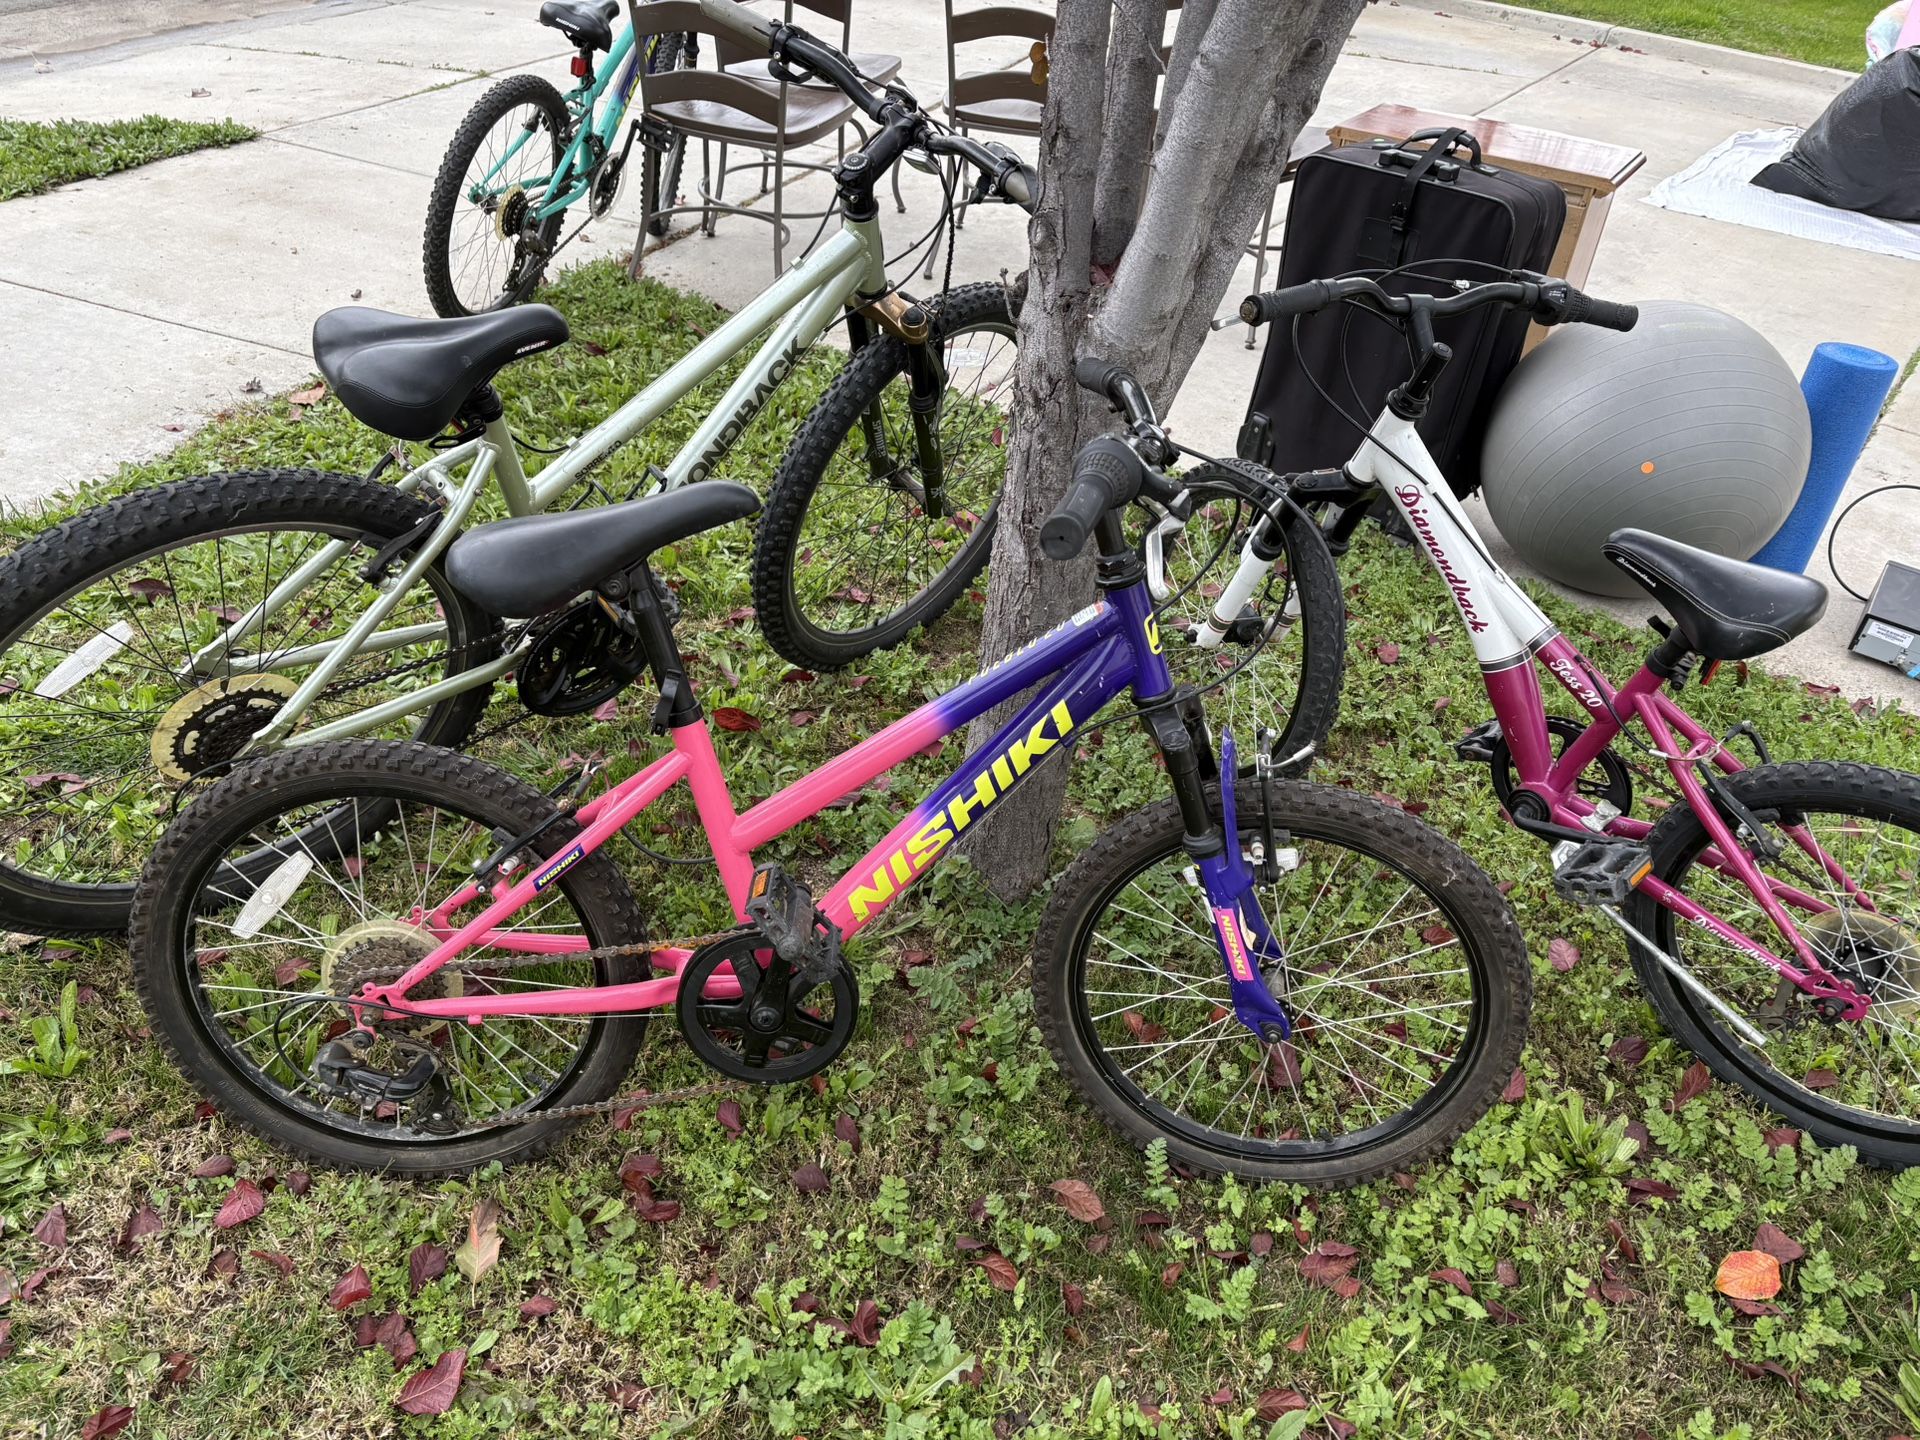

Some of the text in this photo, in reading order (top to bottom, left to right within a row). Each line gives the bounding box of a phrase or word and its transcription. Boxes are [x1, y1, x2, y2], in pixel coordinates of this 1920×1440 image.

[678, 334, 808, 488] ONDBACK
[1394, 484, 1489, 634] Diamondback
[1549, 658, 1603, 709] Tess 20
[848, 698, 1074, 922] NISHIKI
[538, 850, 580, 887] NISHIKI
[1694, 914, 1782, 972] Diamondback
